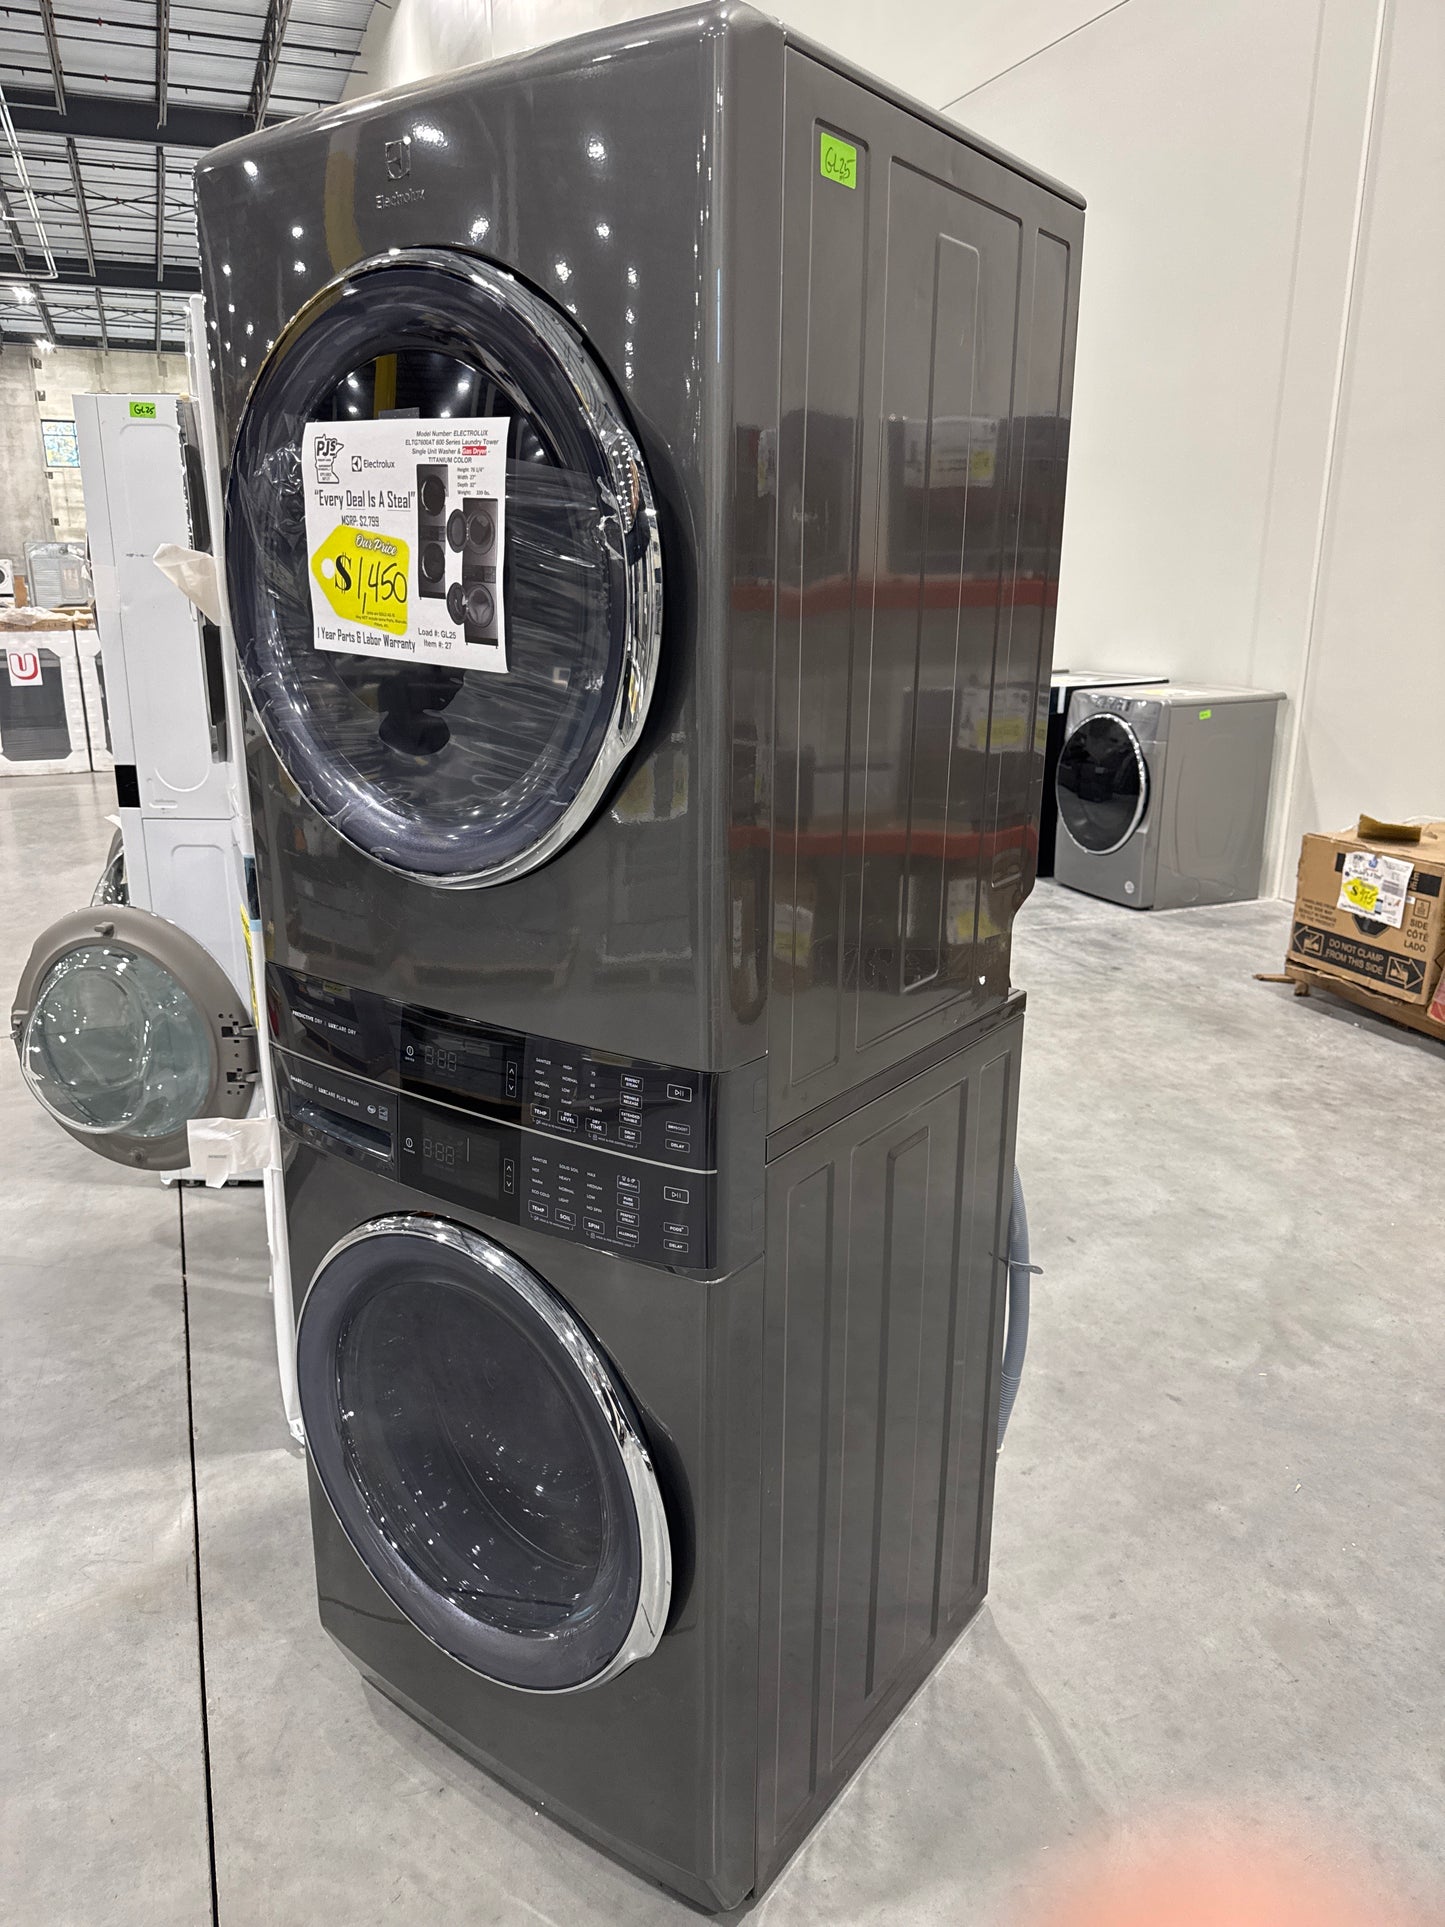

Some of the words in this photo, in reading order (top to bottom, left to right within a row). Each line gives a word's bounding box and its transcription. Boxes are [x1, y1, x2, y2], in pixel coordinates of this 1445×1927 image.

[363, 460, 395, 468] Electrolux
[346, 491, 365, 507] Deal
[368, 491, 376, 507] Is
[379, 491, 385, 508] A
[341, 516, 358, 526] MSRP:
[360, 516, 379, 527] $2,799
[355, 534, 374, 550] Our
[374, 538, 398, 556] Price
[334, 552, 408, 614] $1,450
[418, 628, 432, 637] Load
[440, 630, 456, 639] GL25
[321, 628, 336, 640] Year
[338, 630, 355, 643] Parts
[356, 632, 362, 644] &
[363, 632, 381, 646] Labor
[383, 634, 415, 652] Warranty
[424, 639, 436, 647] Item
[444, 641, 452, 649] 27
[10, 653, 38, 680] U
[1410, 919, 1428, 930] SIDE
[1407, 929, 1428, 942] CÔTÉ
[1329, 939, 1340, 947] DO
[1342, 943, 1356, 954] NOT
[1357, 948, 1384, 962] CLAMP
[1404, 940, 1426, 952] LADO
[1326, 949, 1346, 961] FROM
[1348, 957, 1364, 968] THIS
[1365, 962, 1383, 975] SIDE
[562, 1076, 578, 1084] NORMAL
[534, 1108, 547, 1116] TEMP
[560, 1116, 575, 1124] LEVEL
[590, 1123, 602, 1131] TIME
[587, 1183, 602, 1191] MEDIUM
[560, 1213, 571, 1222] SOIL
[588, 1222, 600, 1230] SPIN
